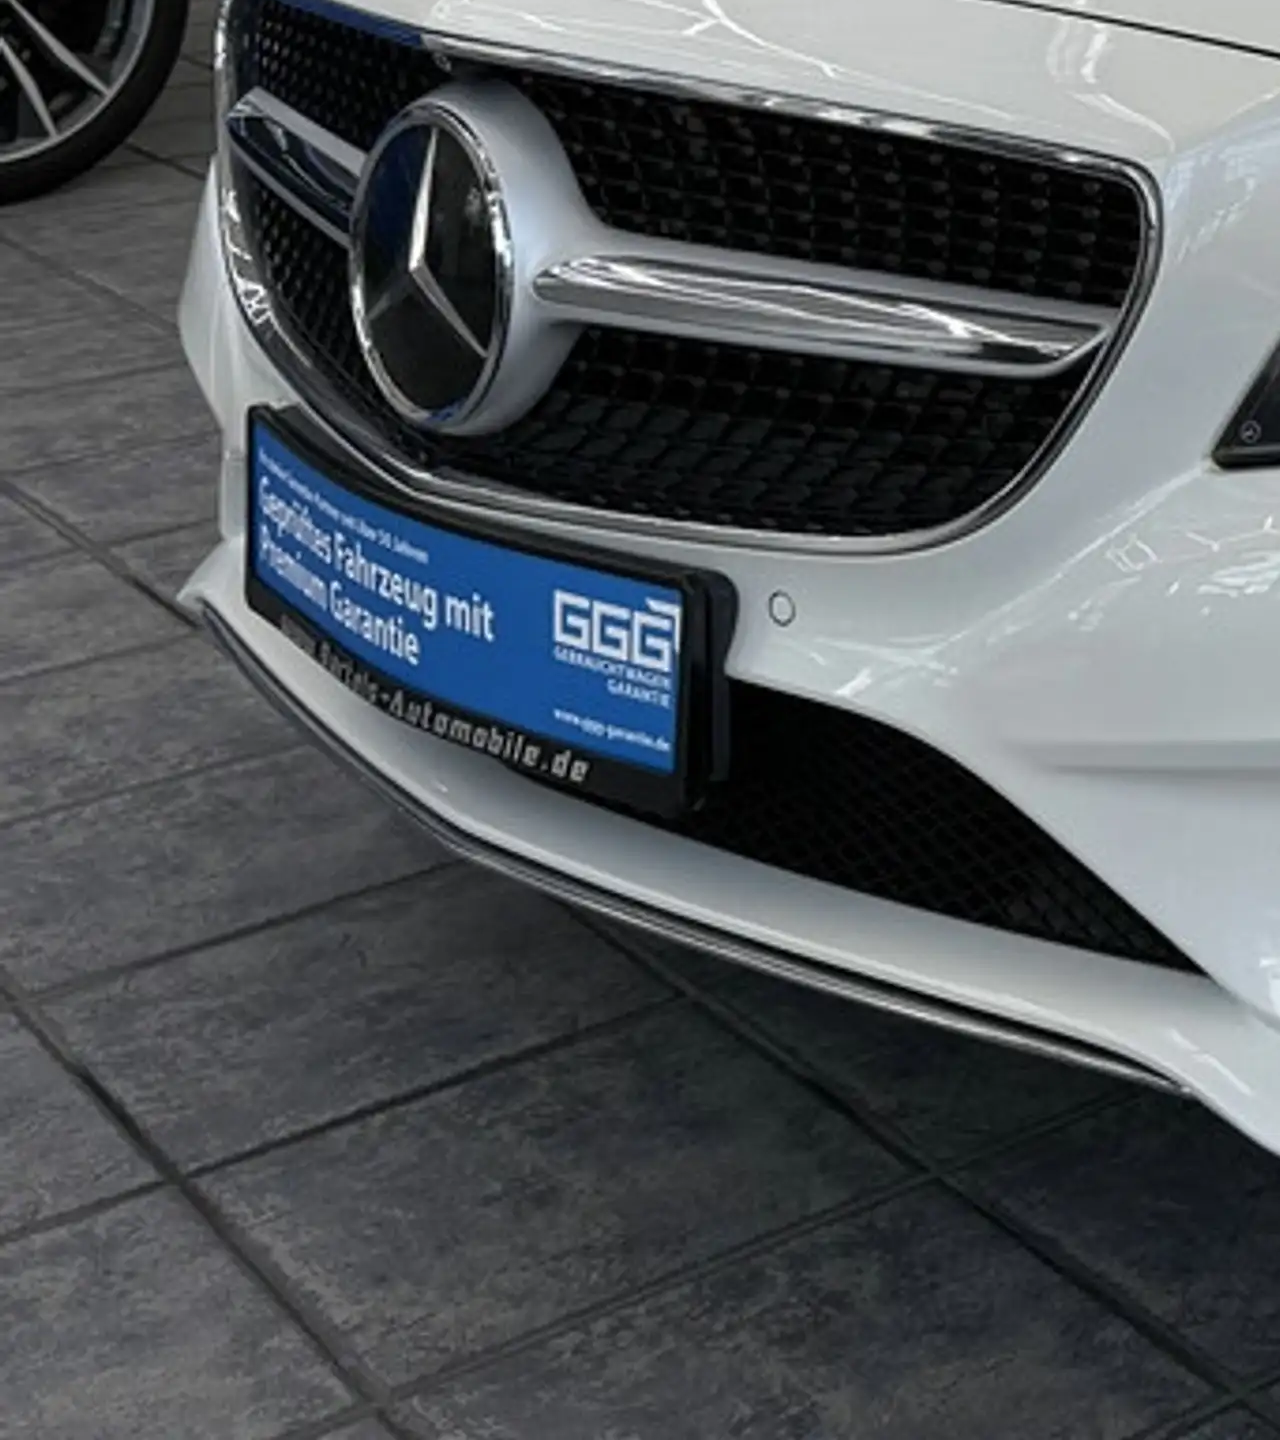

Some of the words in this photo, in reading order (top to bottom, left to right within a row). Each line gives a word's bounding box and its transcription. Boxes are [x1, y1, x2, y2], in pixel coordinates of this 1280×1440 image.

[330, 580, 420, 665] Garantie
[334, 530, 438, 630] Fahrzeug
[445, 592, 496, 643] mit
